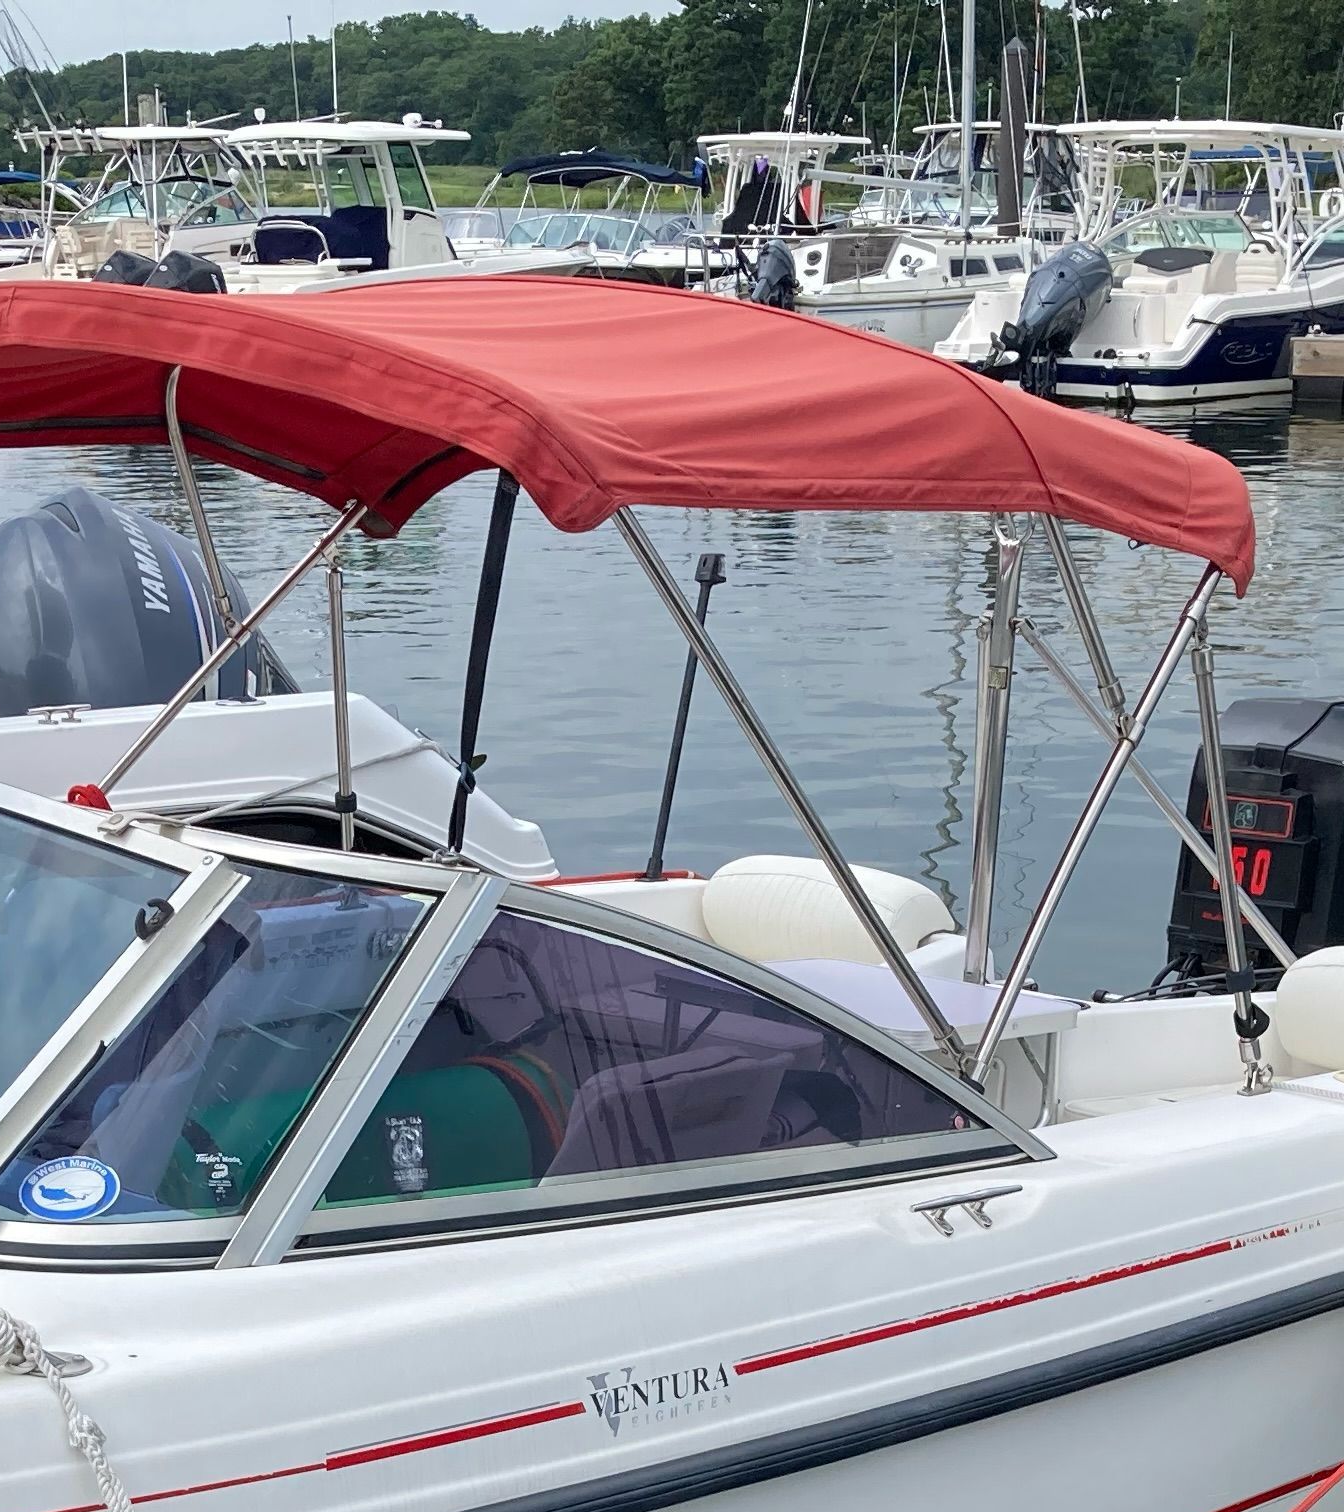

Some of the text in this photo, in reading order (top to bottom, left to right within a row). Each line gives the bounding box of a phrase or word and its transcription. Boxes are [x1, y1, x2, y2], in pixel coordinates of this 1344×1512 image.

[112, 508, 170, 614] YAMAHA
[37, 1160, 108, 1177] West Marine
[590, 1362, 729, 1418] VENTURA
